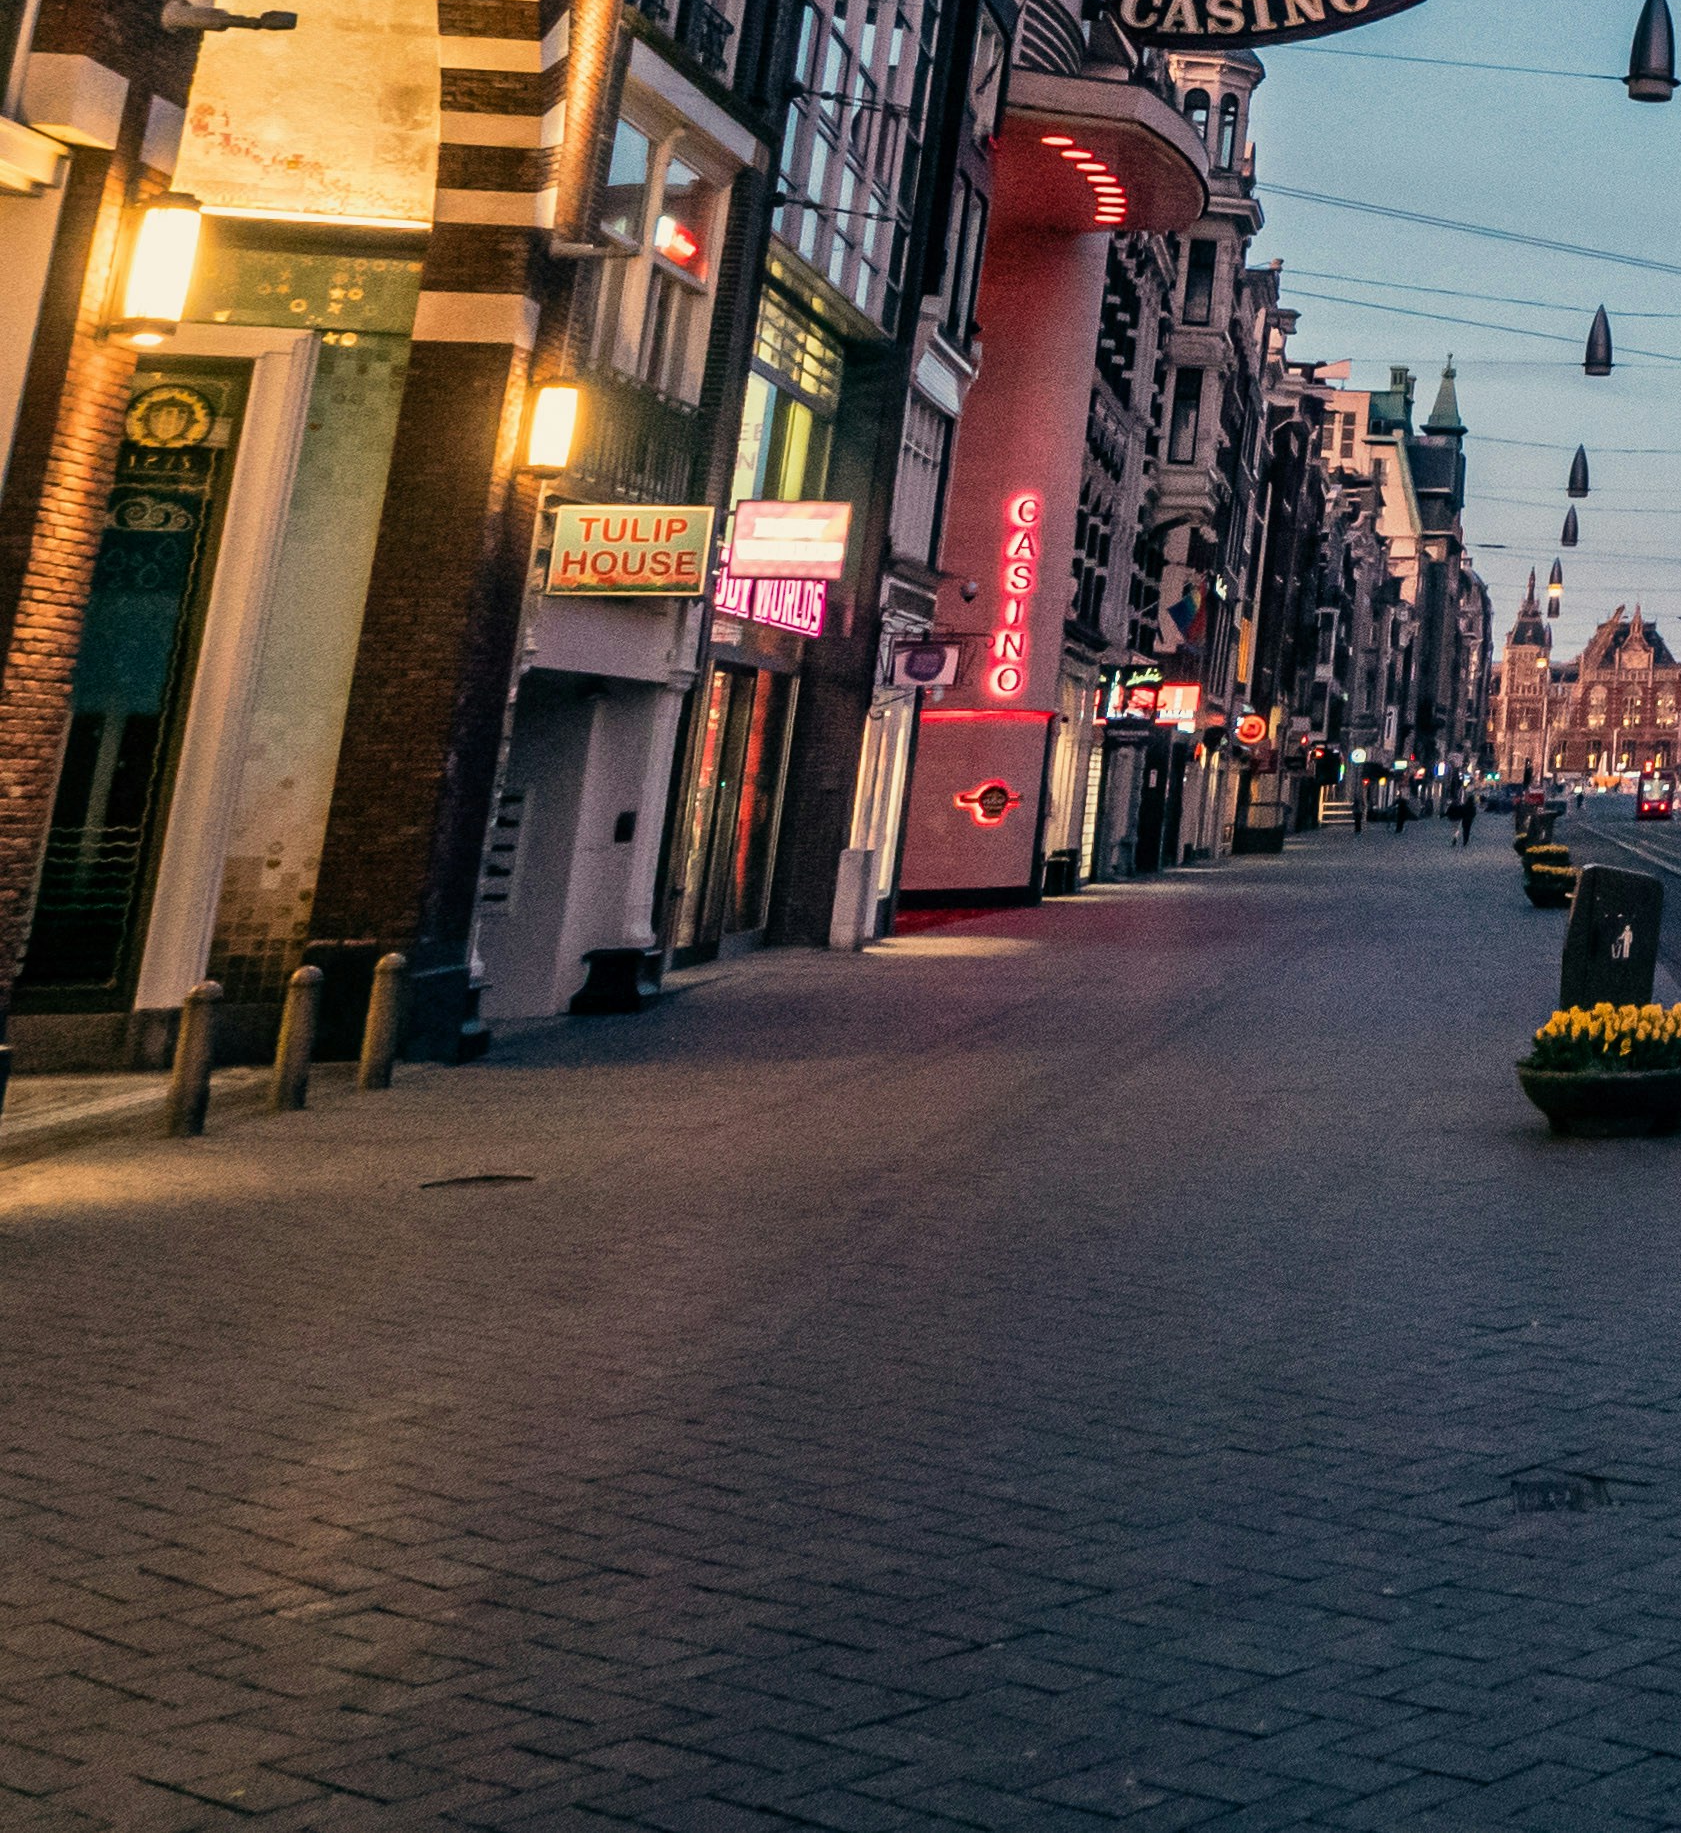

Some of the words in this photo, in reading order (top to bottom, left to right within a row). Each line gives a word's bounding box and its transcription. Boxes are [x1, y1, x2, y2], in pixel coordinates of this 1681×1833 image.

[578, 517, 688, 543] TULIP
[560, 549, 698, 577] HOUSE
[996, 498, 1041, 692] CASINO
